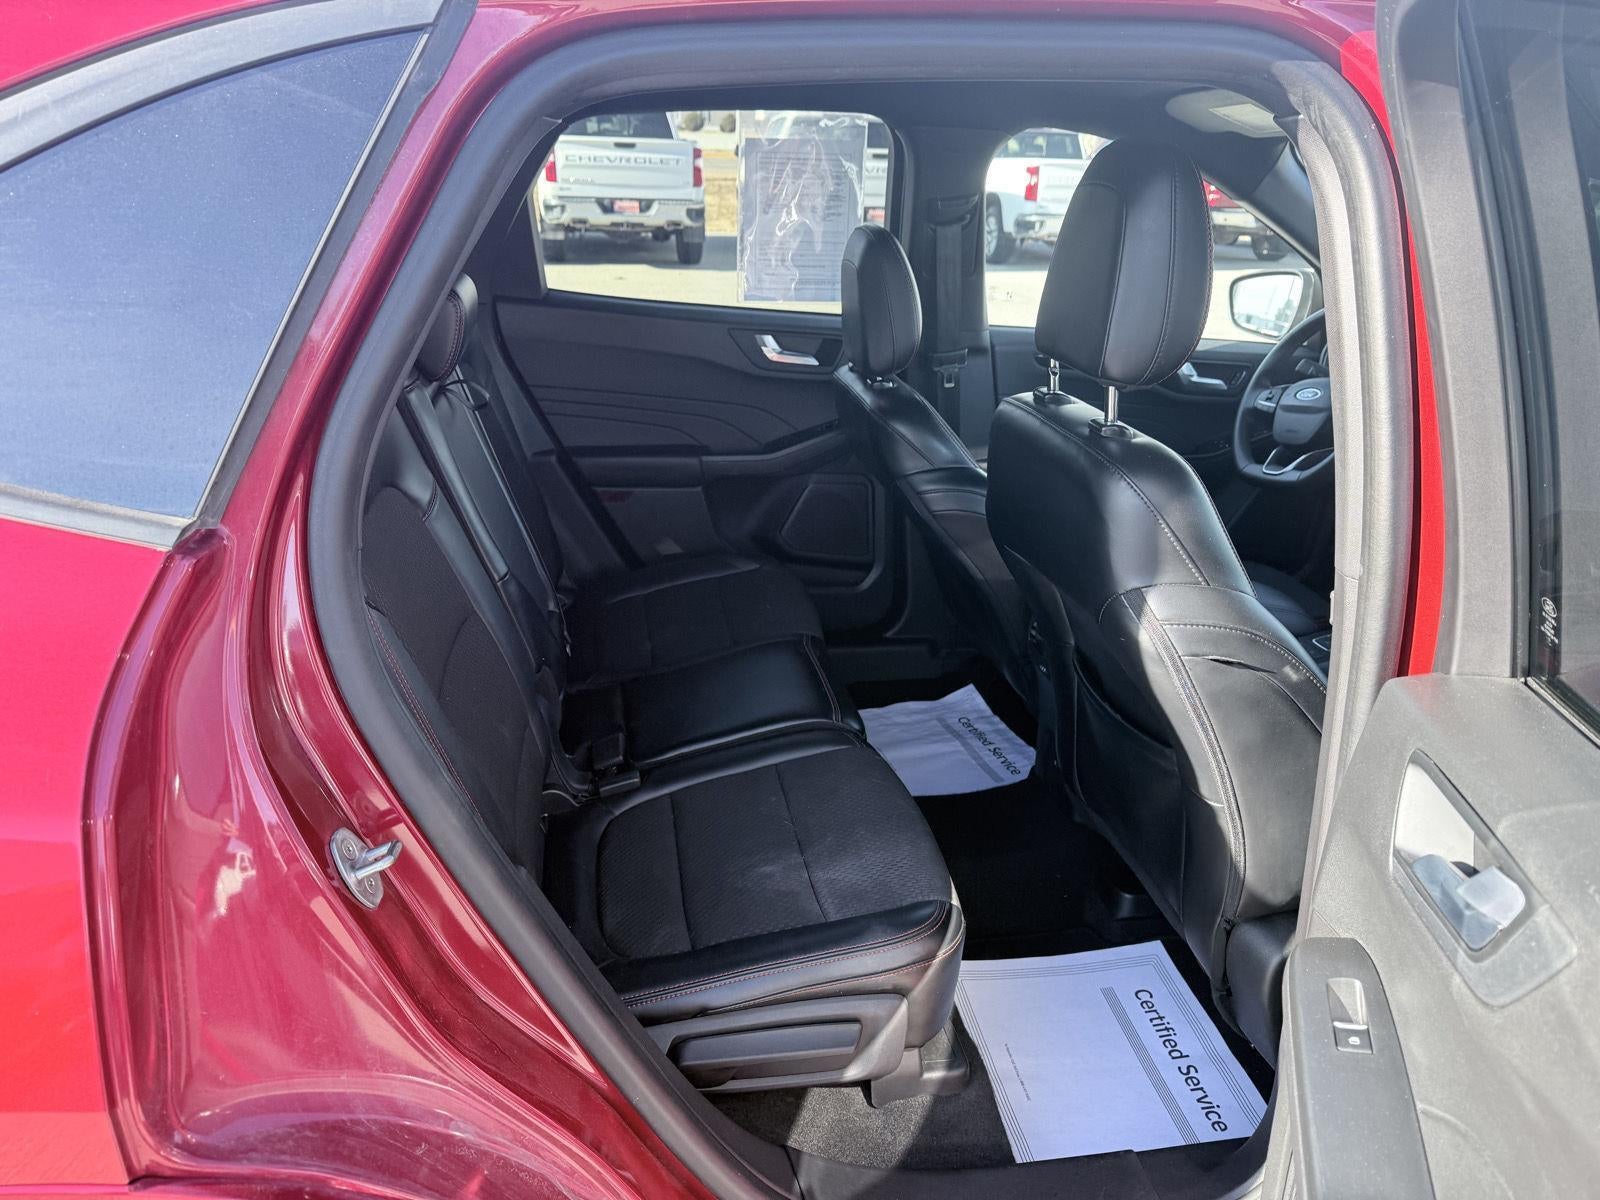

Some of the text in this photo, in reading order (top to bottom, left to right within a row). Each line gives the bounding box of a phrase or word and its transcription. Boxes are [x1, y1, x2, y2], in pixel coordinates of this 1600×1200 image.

[565, 154, 681, 166] CHEVROLET
[958, 716, 1021, 776] Certified Service
[1134, 988, 1229, 1133] Certified Service
